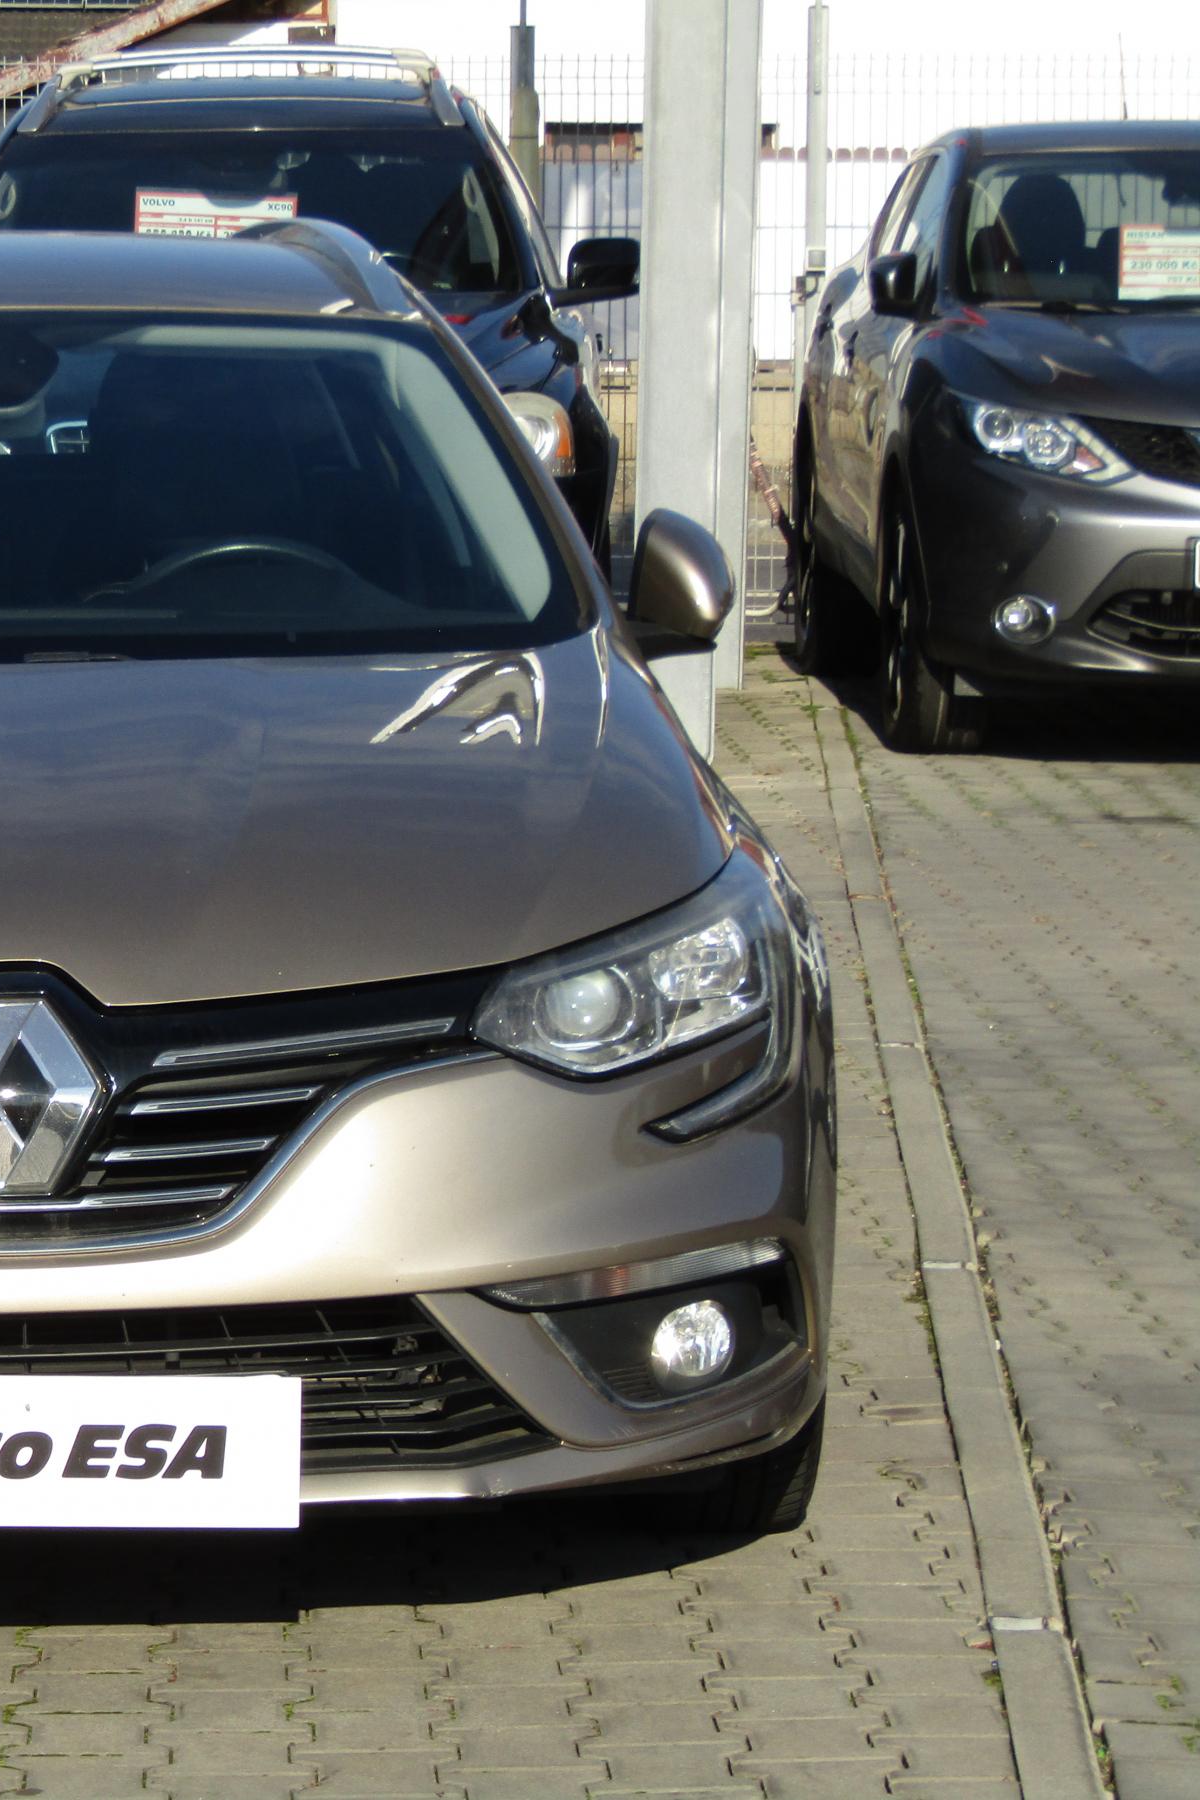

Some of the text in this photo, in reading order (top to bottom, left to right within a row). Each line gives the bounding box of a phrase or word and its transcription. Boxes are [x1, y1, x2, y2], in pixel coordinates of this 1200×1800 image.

[142, 197, 293, 212] VOLVO XC90
[1130, 261, 1152, 270] 230
[1156, 261, 1178, 270] 000
[61, 1423, 228, 1480] ESA
